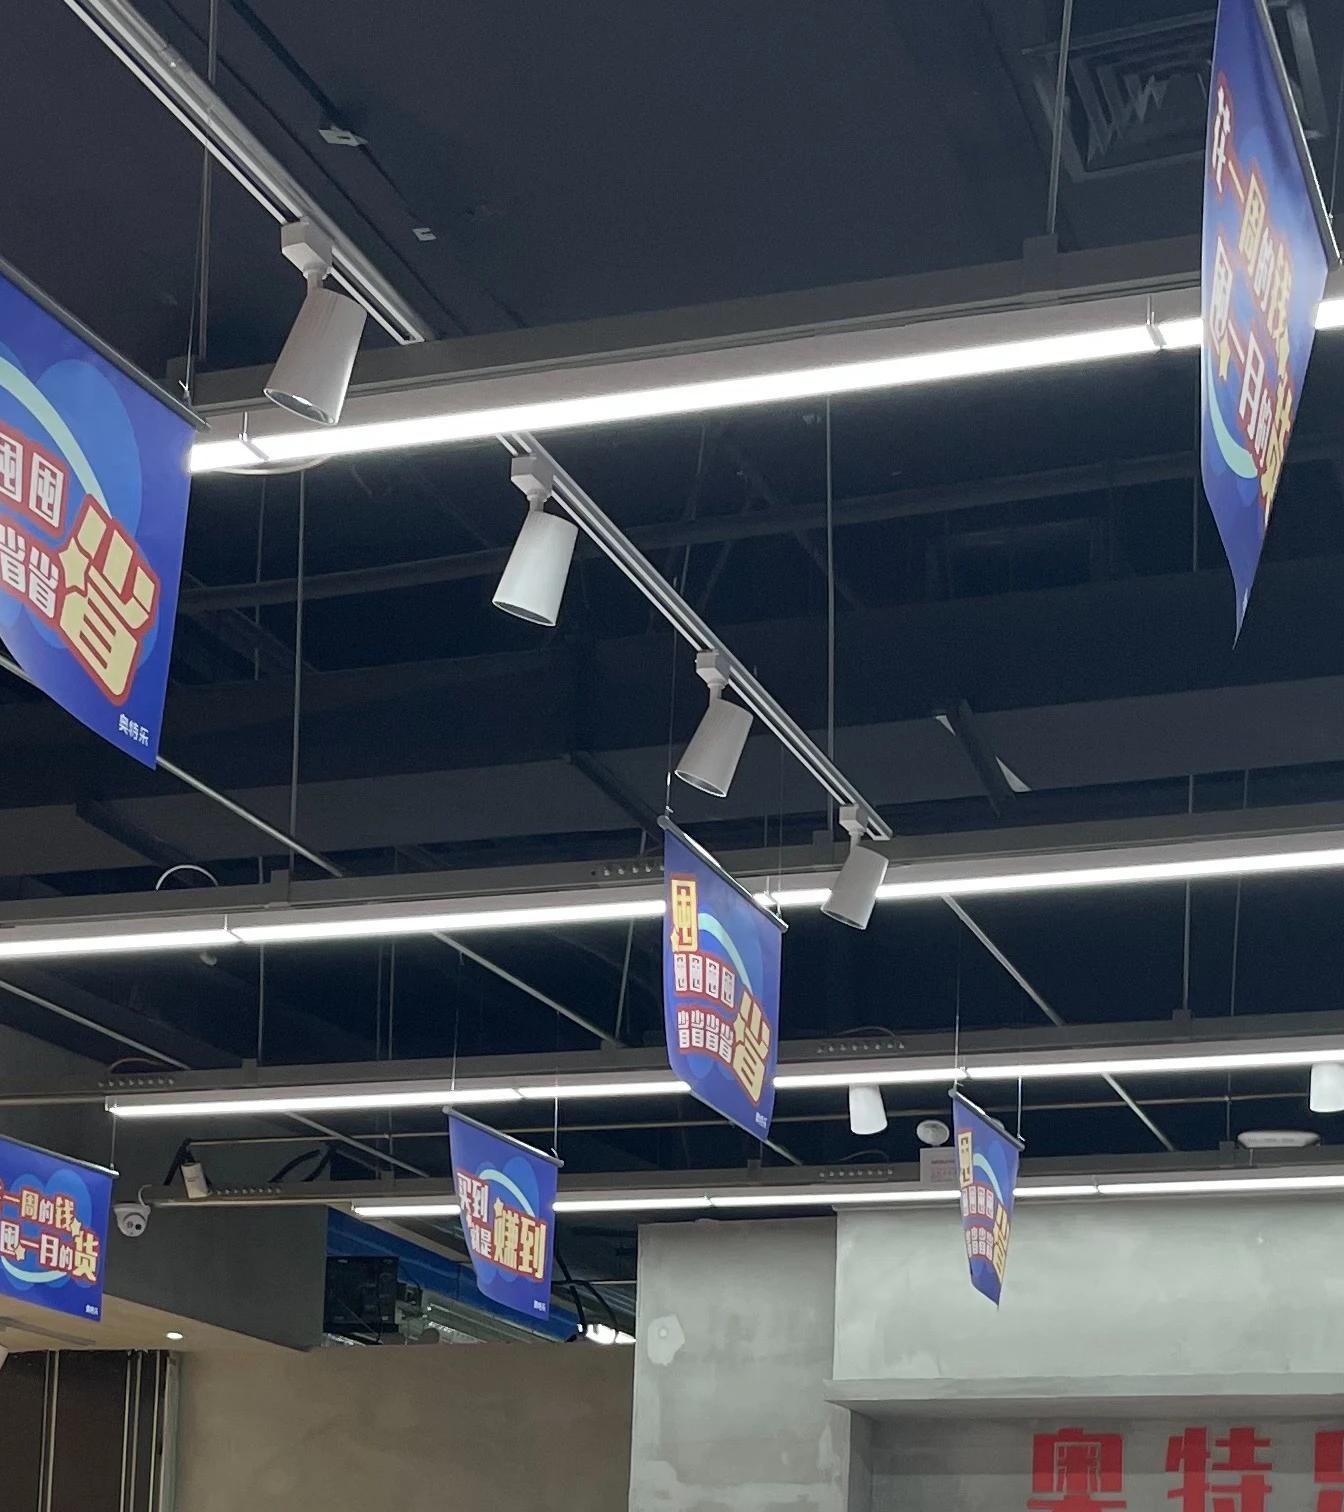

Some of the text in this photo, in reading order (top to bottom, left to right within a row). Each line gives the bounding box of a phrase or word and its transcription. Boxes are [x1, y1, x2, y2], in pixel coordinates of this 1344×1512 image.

[60, 503, 156, 697] 省
[118, 713, 150, 747] 奥特乐
[0, 1220, 99, 1281] 囤一月的货
